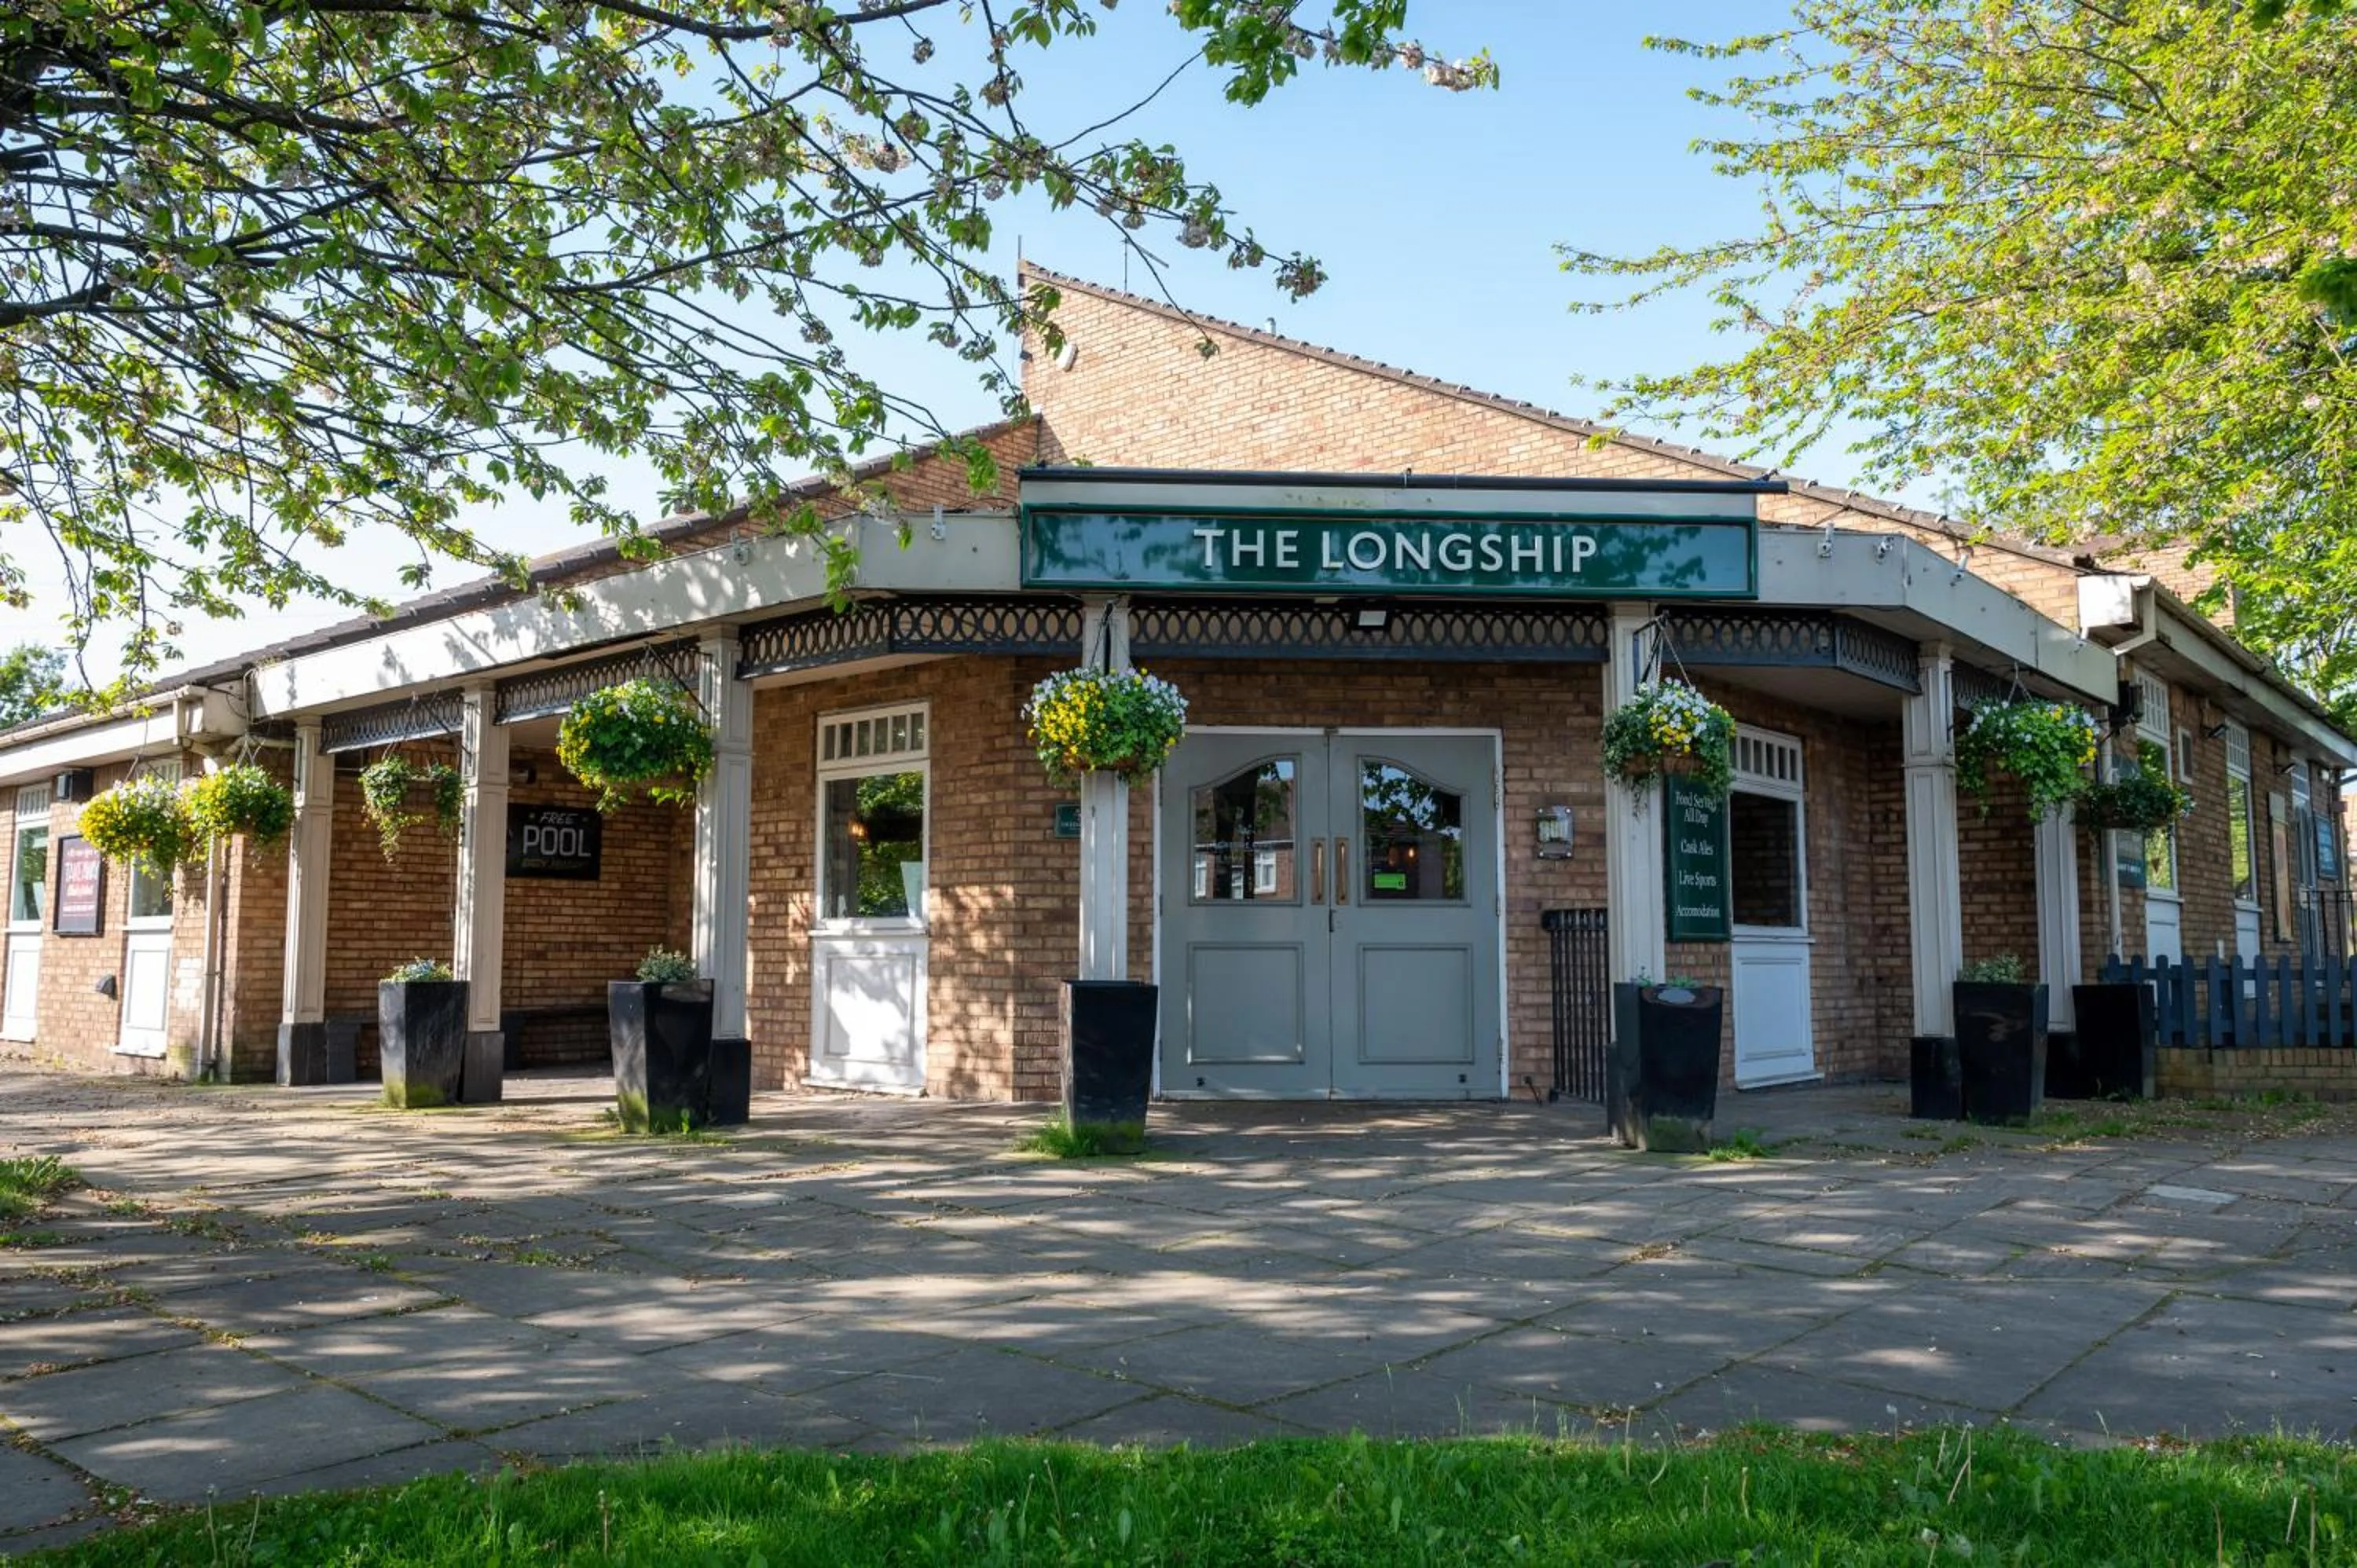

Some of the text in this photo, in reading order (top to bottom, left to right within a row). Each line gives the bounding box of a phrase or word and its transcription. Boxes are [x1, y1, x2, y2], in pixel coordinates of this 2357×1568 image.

[1193, 529, 1597, 573] THE LONGSHIP
[1676, 792, 1693, 807] Food
[1684, 808, 1709, 828] All Day
[523, 825, 592, 857] POOL
[1681, 838, 1714, 855] Cask Ales
[1679, 870, 1717, 890] Live Sports
